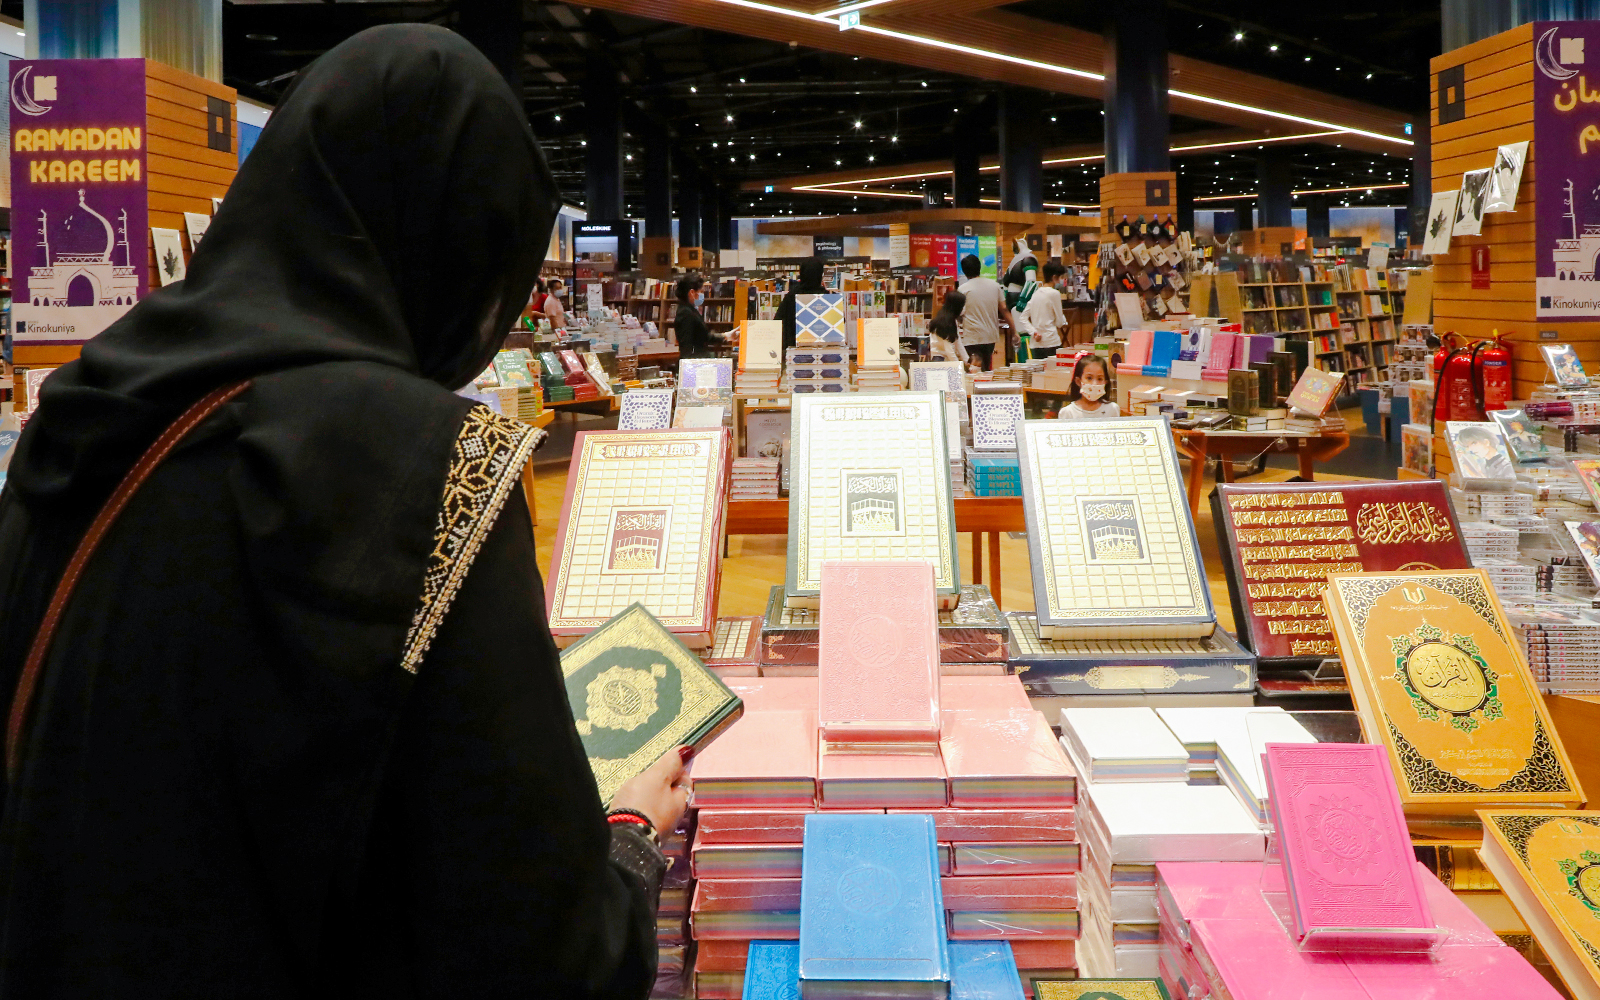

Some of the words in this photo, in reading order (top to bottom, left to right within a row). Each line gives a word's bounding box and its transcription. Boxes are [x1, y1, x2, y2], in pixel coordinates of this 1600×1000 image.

[15, 127, 141, 152] RAMADAN
[30, 159, 141, 183] KAREEM
[28, 323, 75, 334] Kinokuniya
